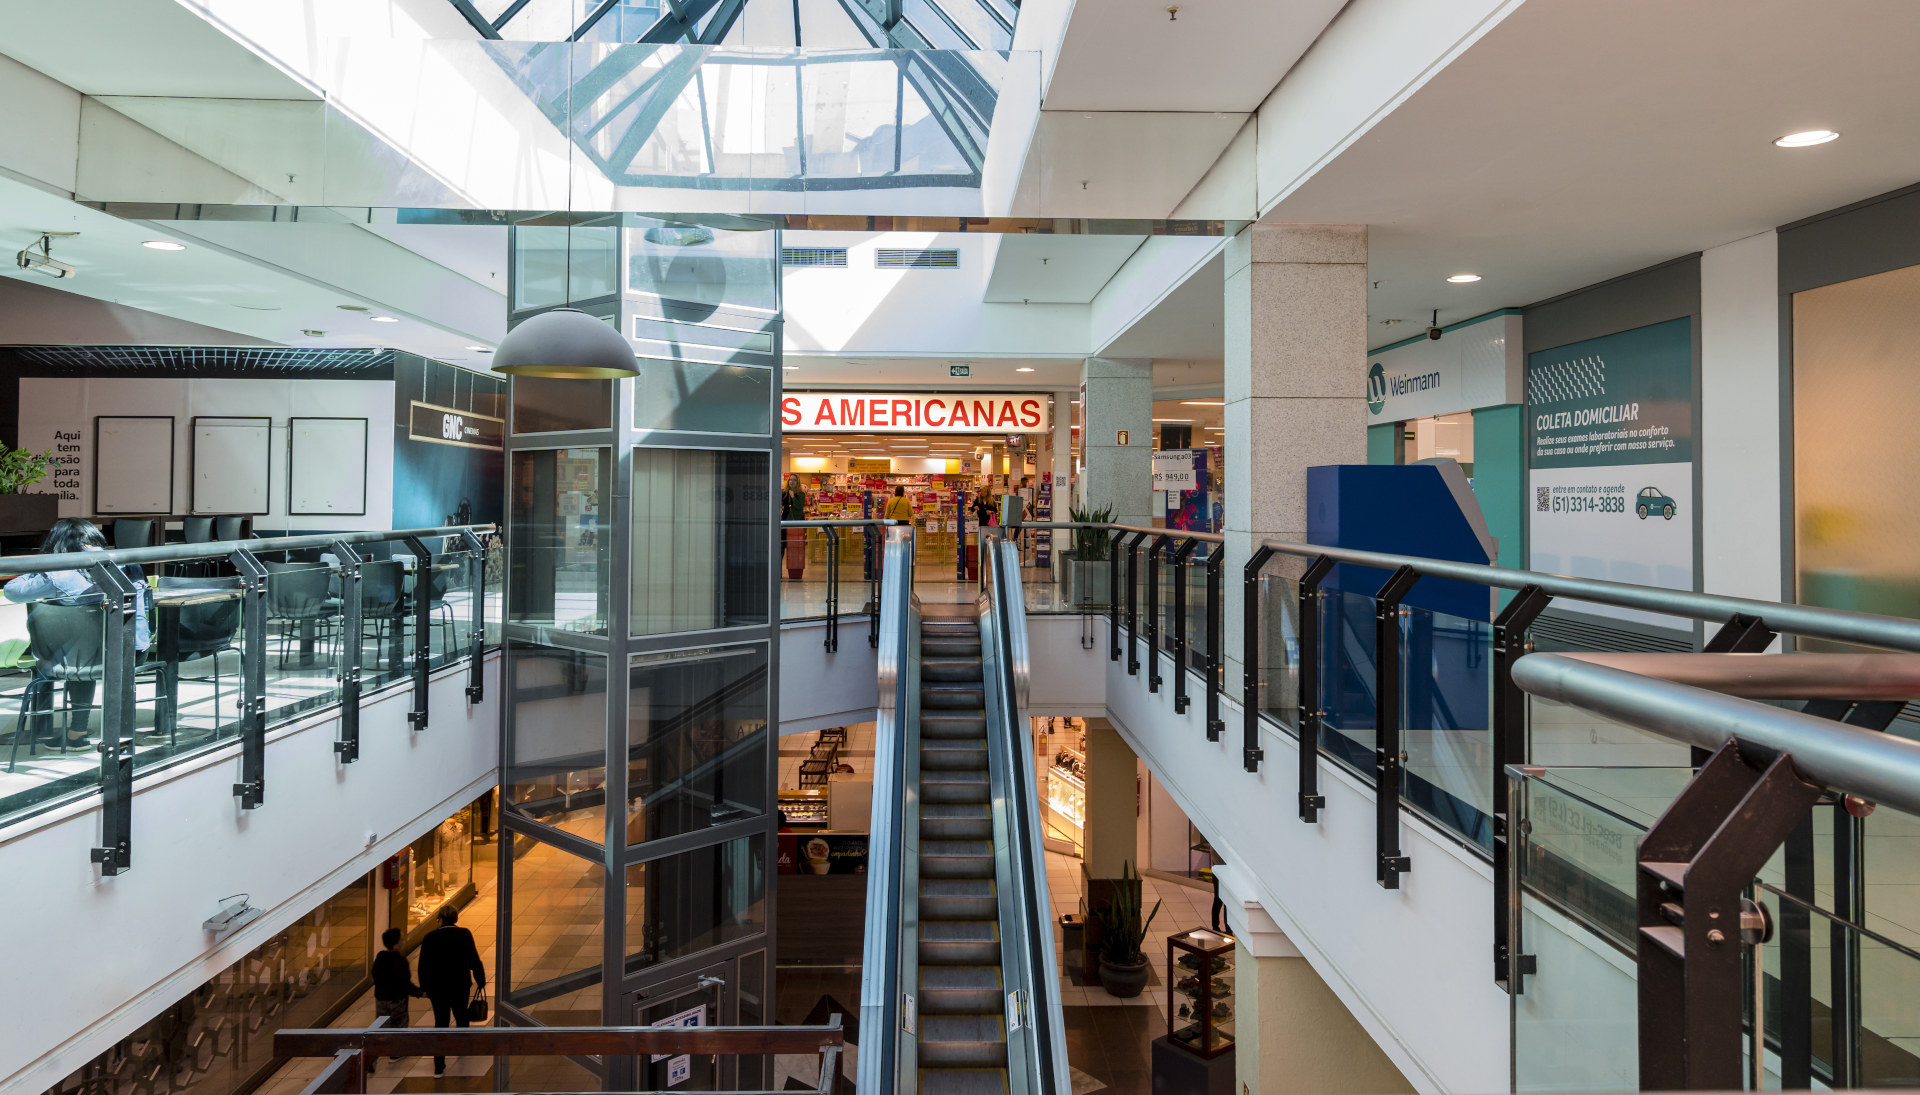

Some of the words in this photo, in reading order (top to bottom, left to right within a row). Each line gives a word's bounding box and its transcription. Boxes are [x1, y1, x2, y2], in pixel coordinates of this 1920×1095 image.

[1390, 371, 1440, 397] Weinmann
[814, 398, 1041, 427] AMERICANAS
[1536, 411, 1572, 431] COLETA
[1574, 403, 1639, 427] DOMICILIAR
[443, 414, 463, 440] GNC
[54, 431, 81, 442] Aqui
[1536, 435, 1555, 446] Realize
[1555, 435, 1567, 444] seus
[1568, 433, 1588, 443] exames
[1589, 429, 1628, 441] laboratoriais
[1629, 429, 1638, 438] no
[1639, 425, 1669, 439] conforto
[57, 443, 80, 452] tem
[1536, 447, 1544, 457] da
[1544, 447, 1553, 456] sua
[1553, 447, 1566, 456] casa
[1567, 446, 1574, 455] ou
[1575, 443, 1589, 453] onde
[1589, 442, 1613, 456] preferir
[1614, 442, 1627, 451] com
[1628, 441, 1647, 450] nosso
[1648, 437, 1675, 450] serviço.
[32, 455, 80, 464] diersão
[55, 469, 80, 478] para
[1165, 473, 1189, 481] 949,00
[53, 479, 80, 488] toda
[1552, 485, 1567, 494] entre
[1567, 486, 1576, 494] em
[1576, 485, 1598, 494] contato
[1602, 483, 1625, 496] agende
